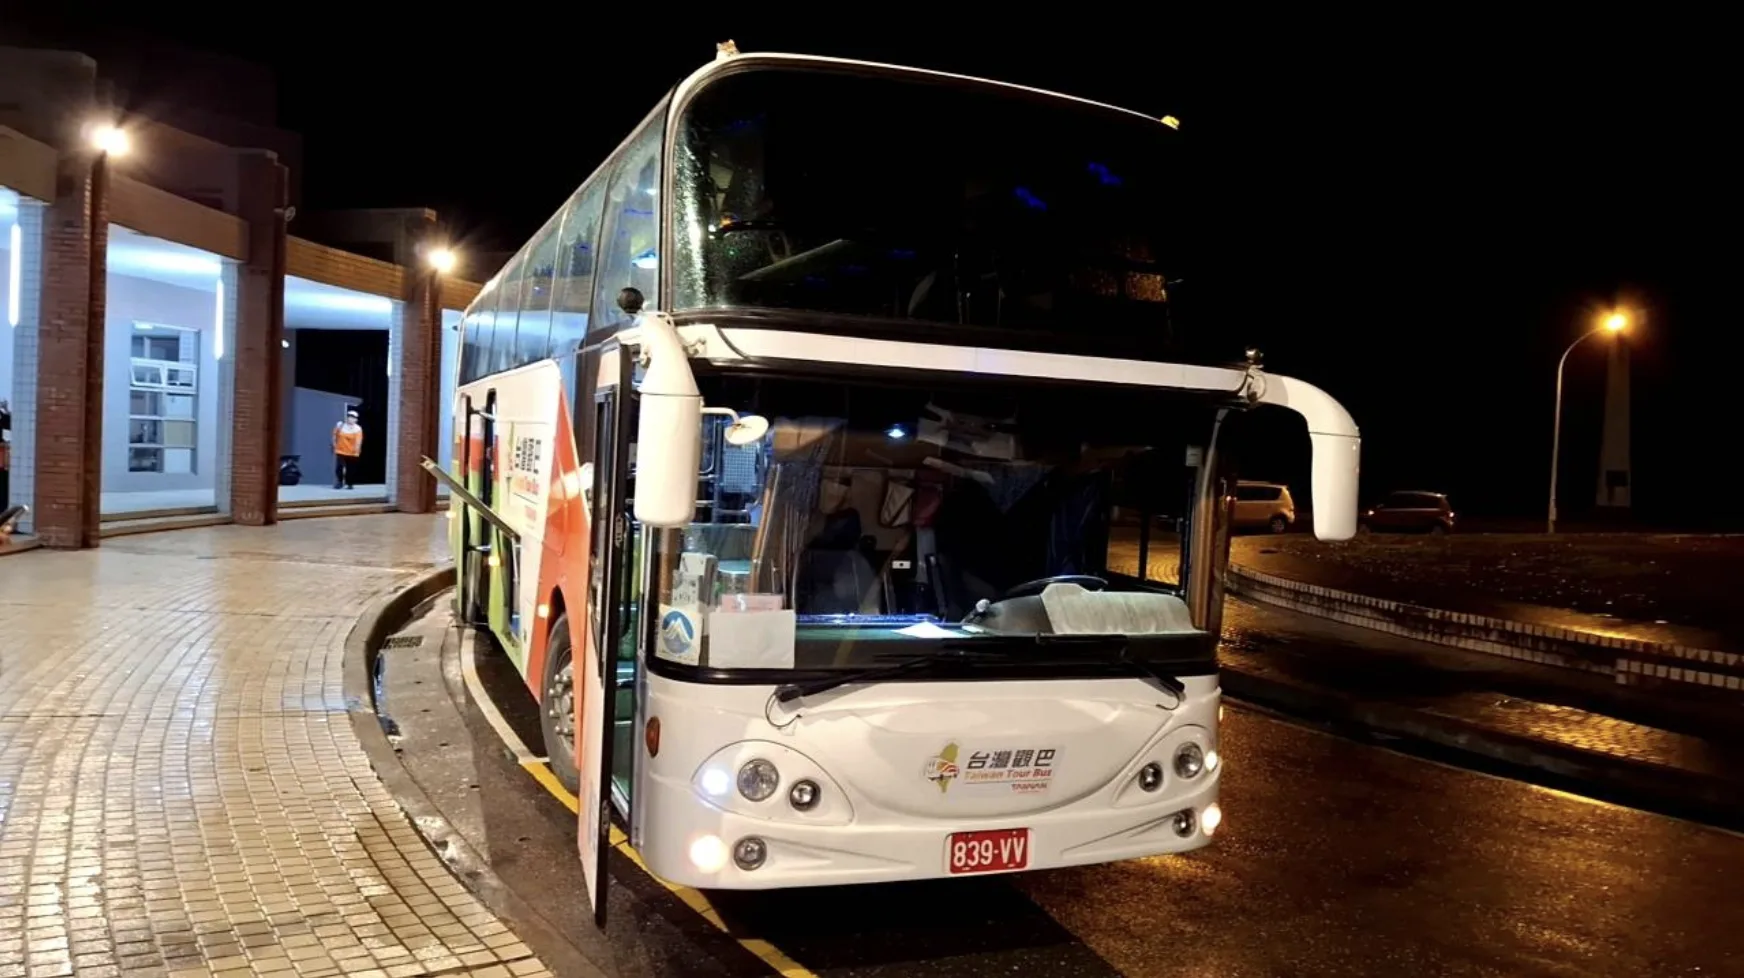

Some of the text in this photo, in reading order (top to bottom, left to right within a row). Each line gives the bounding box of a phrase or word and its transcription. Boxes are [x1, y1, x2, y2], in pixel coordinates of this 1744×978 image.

[967, 749, 1056, 770] 台灣觀巴
[964, 768, 1053, 781] Taiwan Tour Bus
[953, 837, 1025, 868] 839-VV
